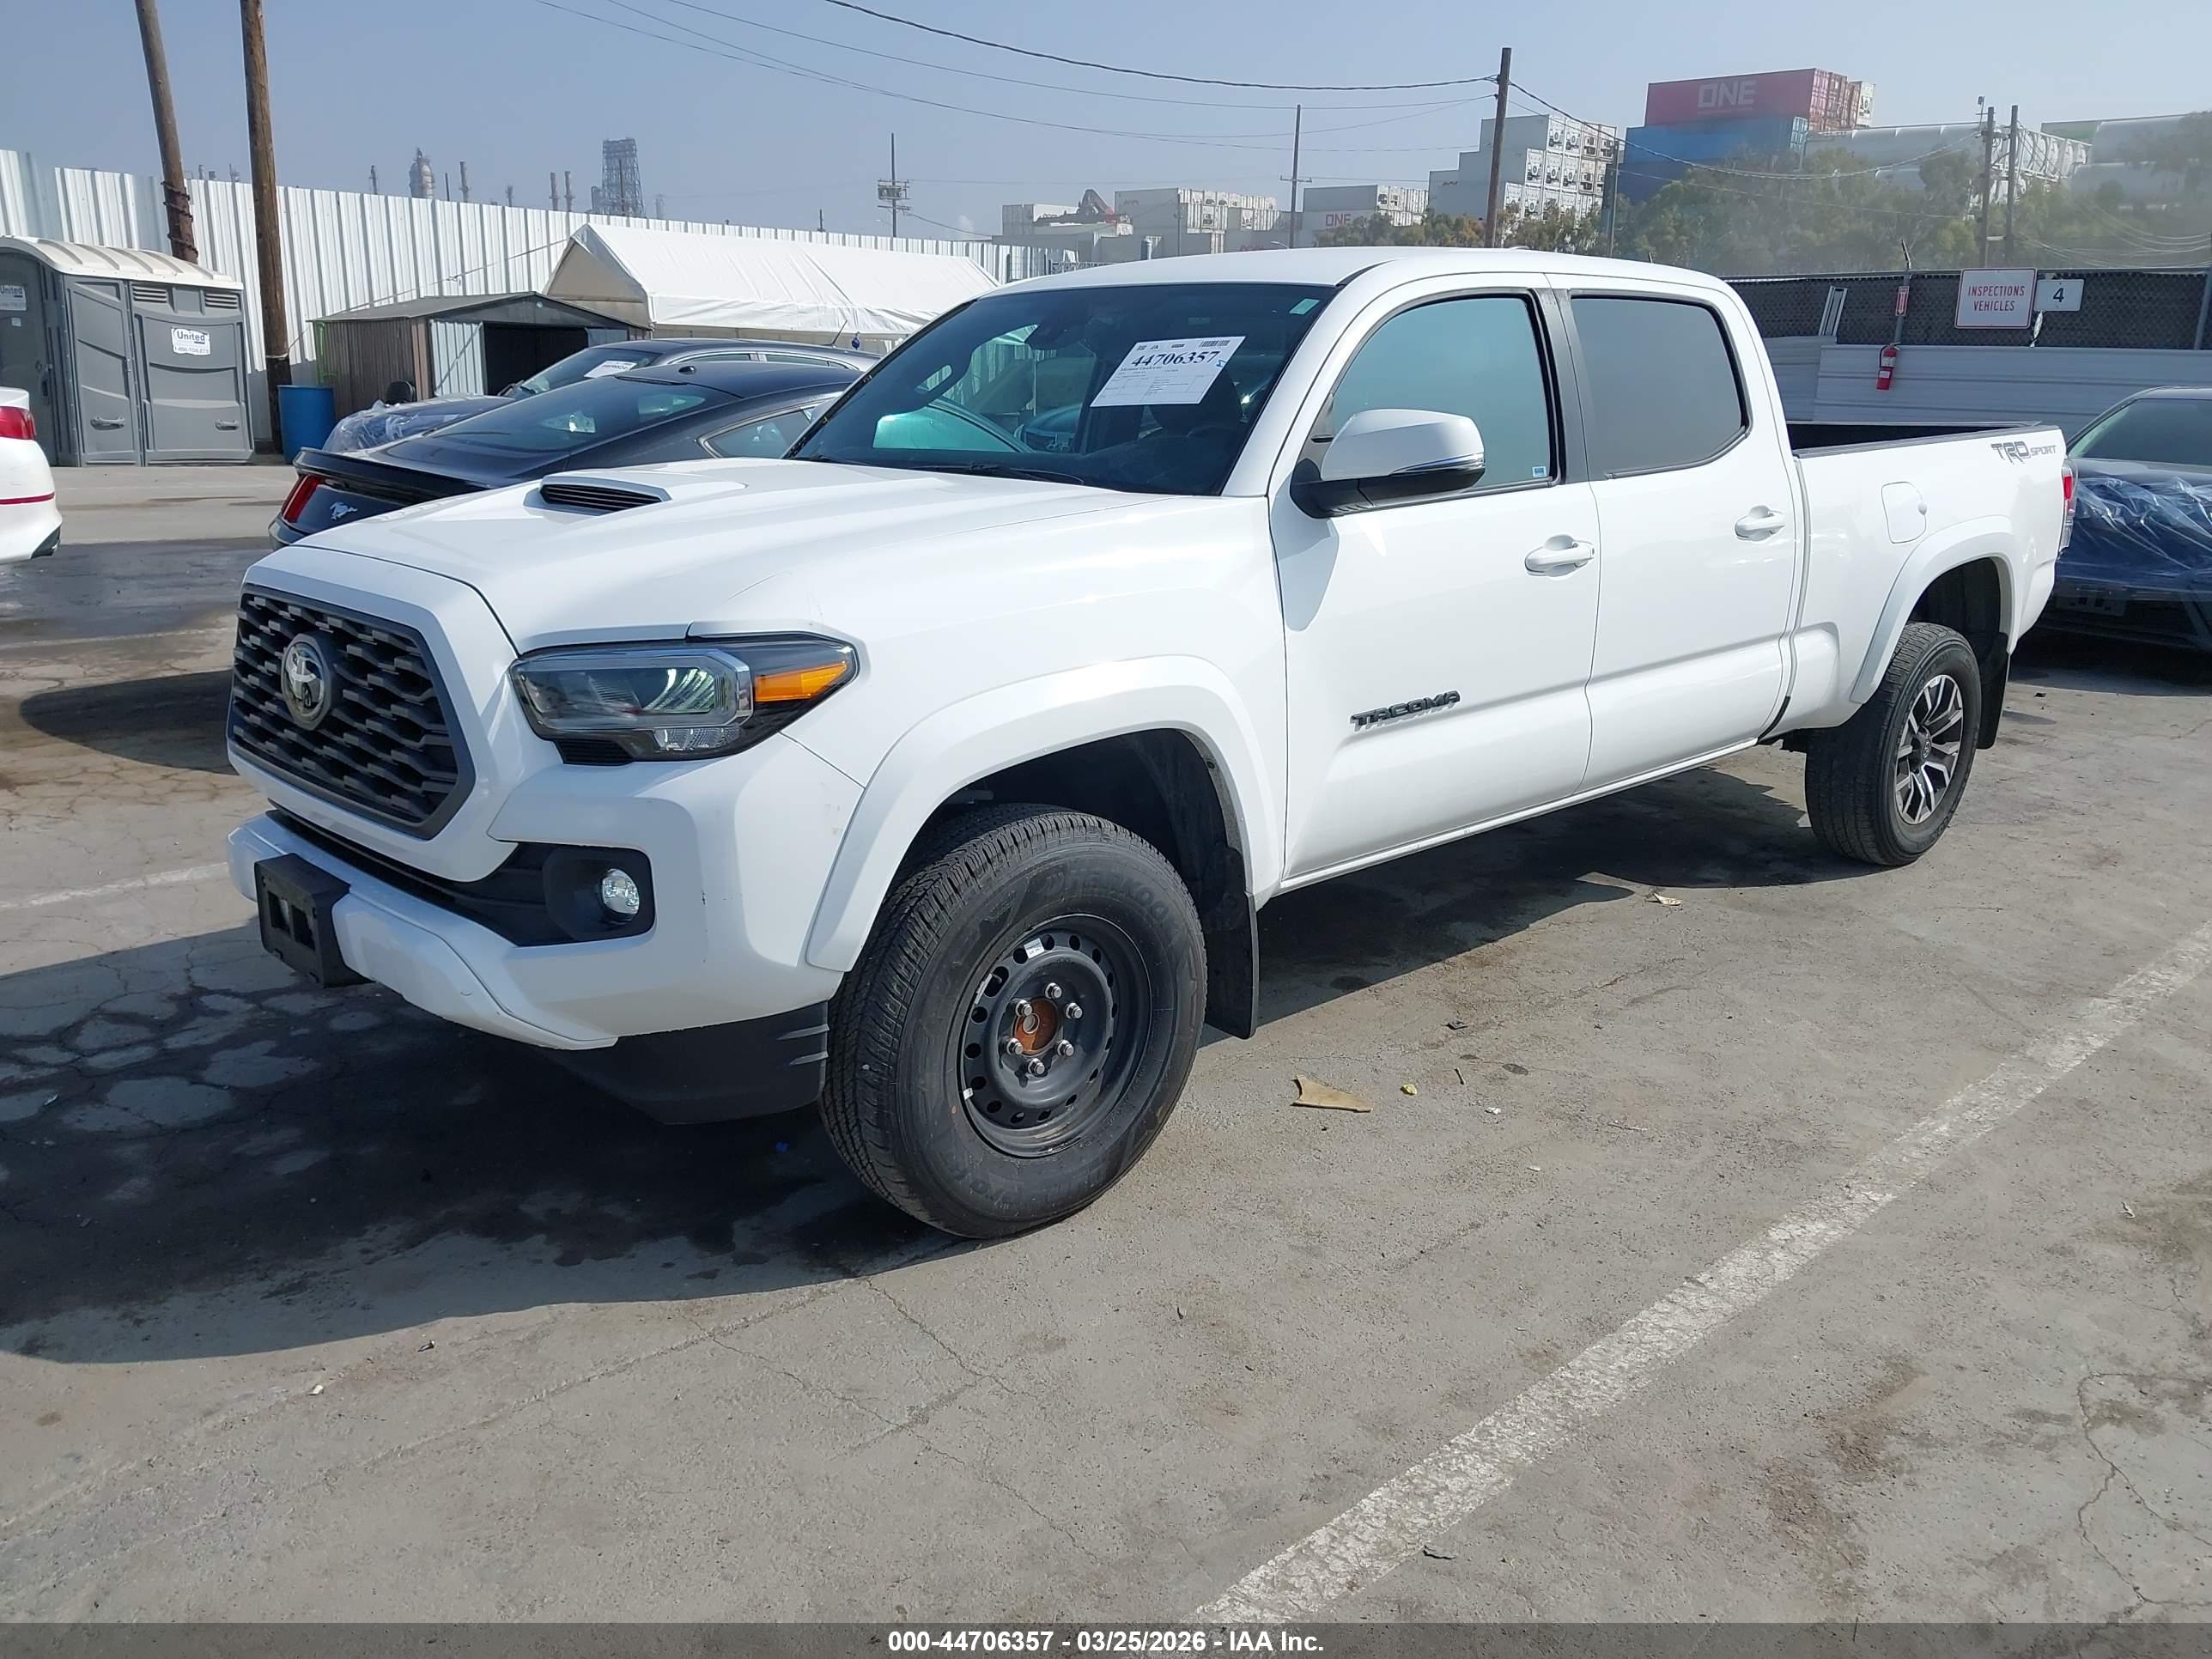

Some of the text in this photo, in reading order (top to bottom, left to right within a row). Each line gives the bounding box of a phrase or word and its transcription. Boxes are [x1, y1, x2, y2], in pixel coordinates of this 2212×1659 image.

[1698, 80, 1757, 108] ONE
[1968, 285, 2026, 296] INSPECTIONS
[2052, 288, 2064, 302] 4
[1973, 301, 2014, 311] VEHICLES
[177, 331, 205, 341] United
[1131, 350, 1221, 367] 44706357
[1990, 441, 2057, 465] TRD SPORT
[1350, 690, 1461, 728] TACOMA
